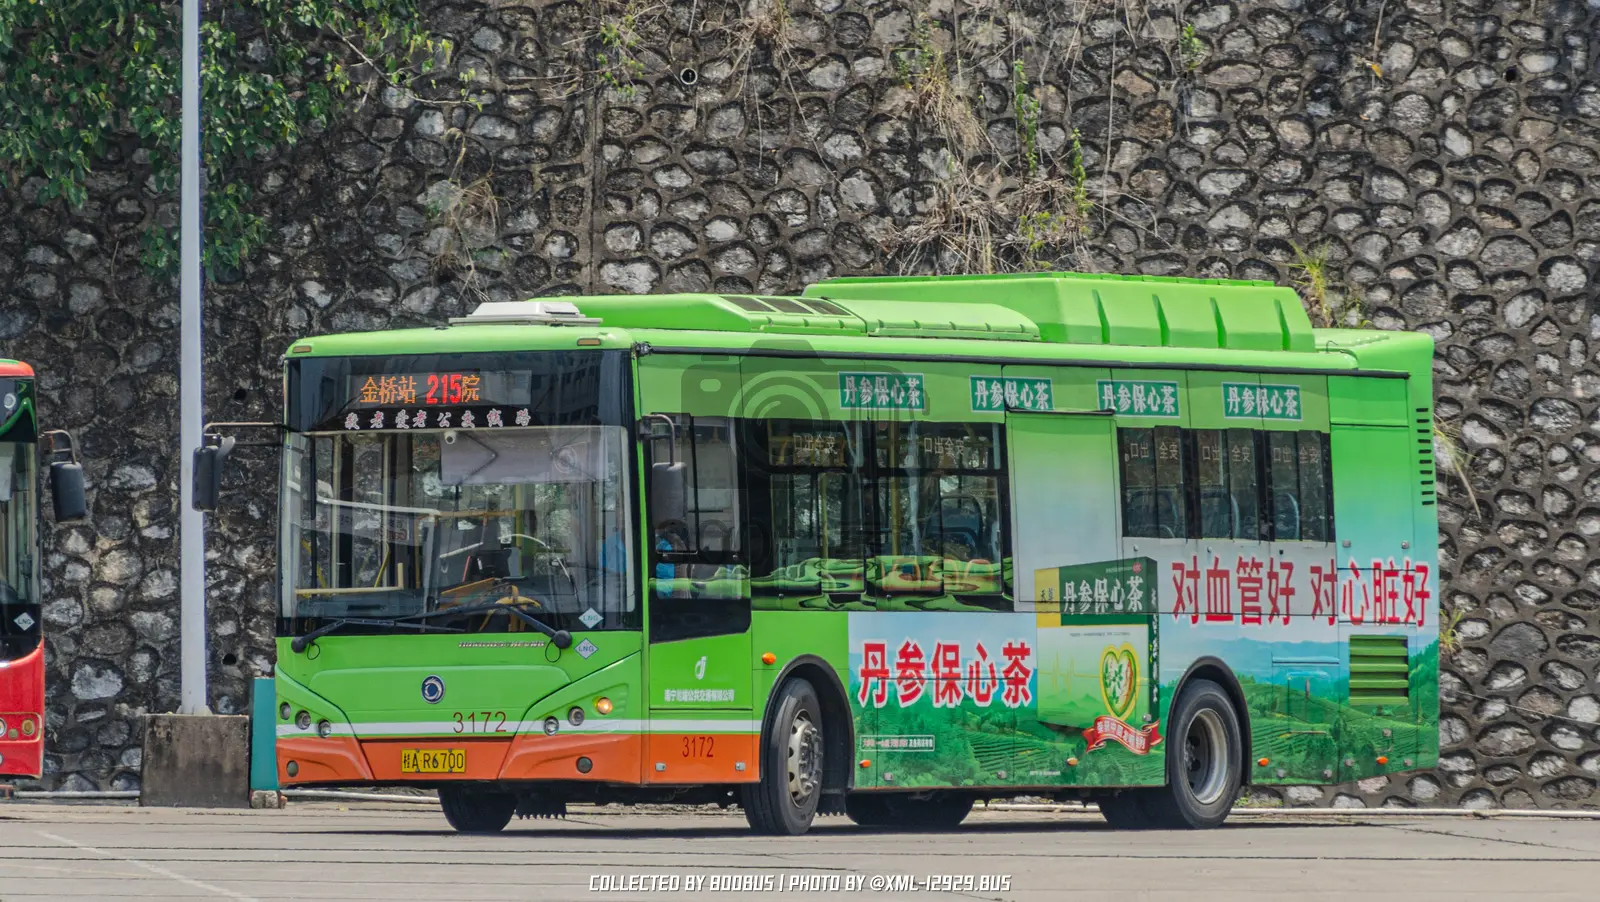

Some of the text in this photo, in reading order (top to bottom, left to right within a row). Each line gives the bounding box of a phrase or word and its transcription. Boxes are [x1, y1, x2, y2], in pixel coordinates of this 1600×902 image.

[360, 376, 417, 404] 金桥站
[843, 375, 921, 407] 丹参保心茶
[974, 379, 1050, 410] 丹参保心茶
[1101, 383, 1177, 414] 丹参保心茶
[1226, 386, 1299, 417] 丹参保心茶
[1063, 575, 1144, 615] 丹参保心茶
[1171, 556, 1431, 627] 对血管好 对心脏好
[859, 639, 1033, 708] 丹参保心茶
[452, 711, 507, 733] 3172
[682, 736, 714, 758] 3172
